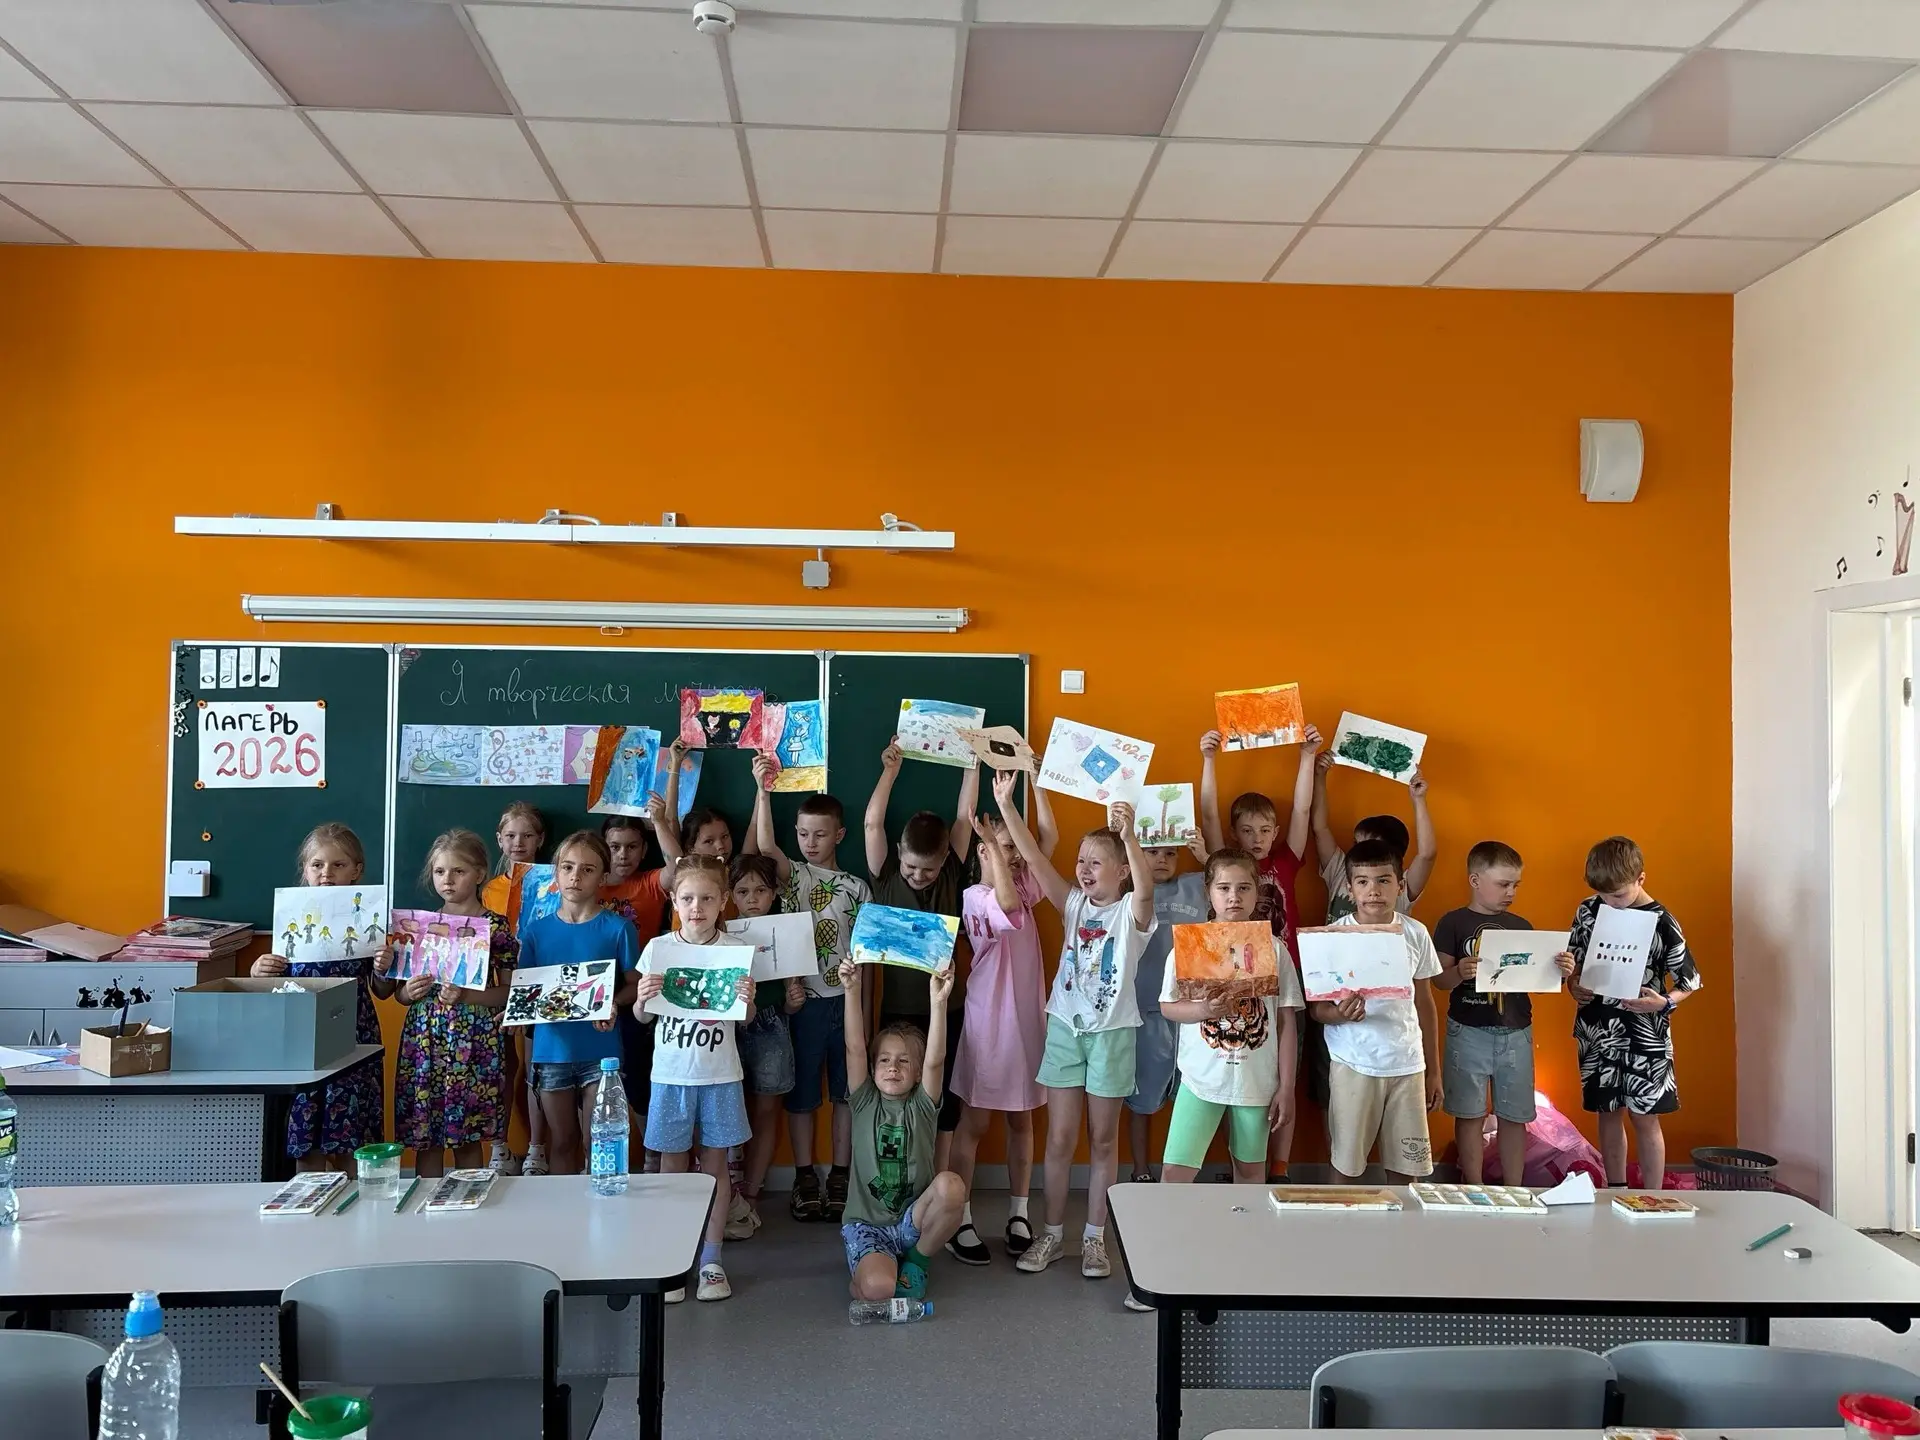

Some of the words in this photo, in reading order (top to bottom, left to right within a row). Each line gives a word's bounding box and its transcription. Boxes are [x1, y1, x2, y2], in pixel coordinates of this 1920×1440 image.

[440, 659, 468, 706] Я
[488, 667, 631, 720] творческая
[205, 710, 299, 735] ЛАГЕРЬ
[213, 732, 321, 780] 2026
[1111, 738, 1149, 763] 2026
[677, 1021, 724, 1053] Hop
